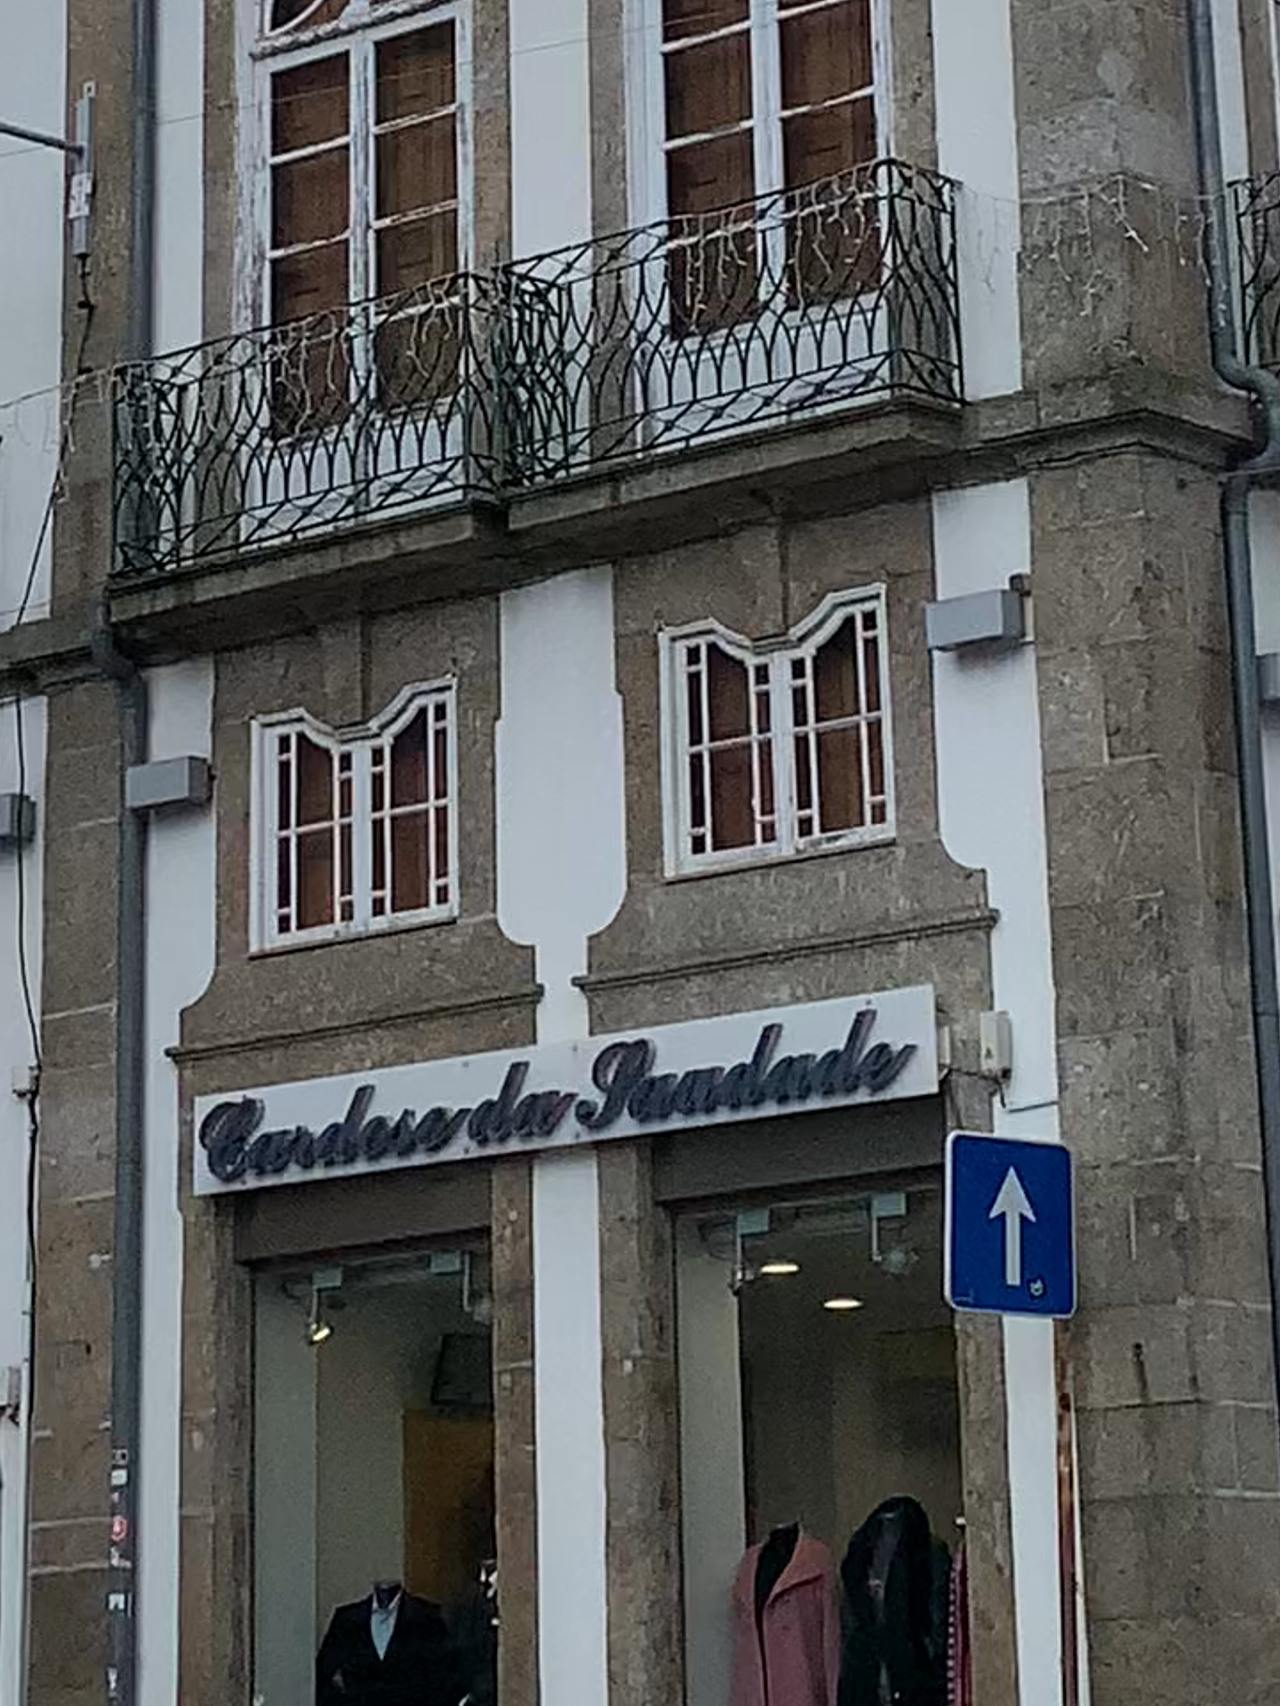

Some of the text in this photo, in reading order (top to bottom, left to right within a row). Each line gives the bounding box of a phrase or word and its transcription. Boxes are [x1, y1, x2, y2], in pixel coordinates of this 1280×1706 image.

[199, 1009, 919, 1183] Cardoso da Saudade
